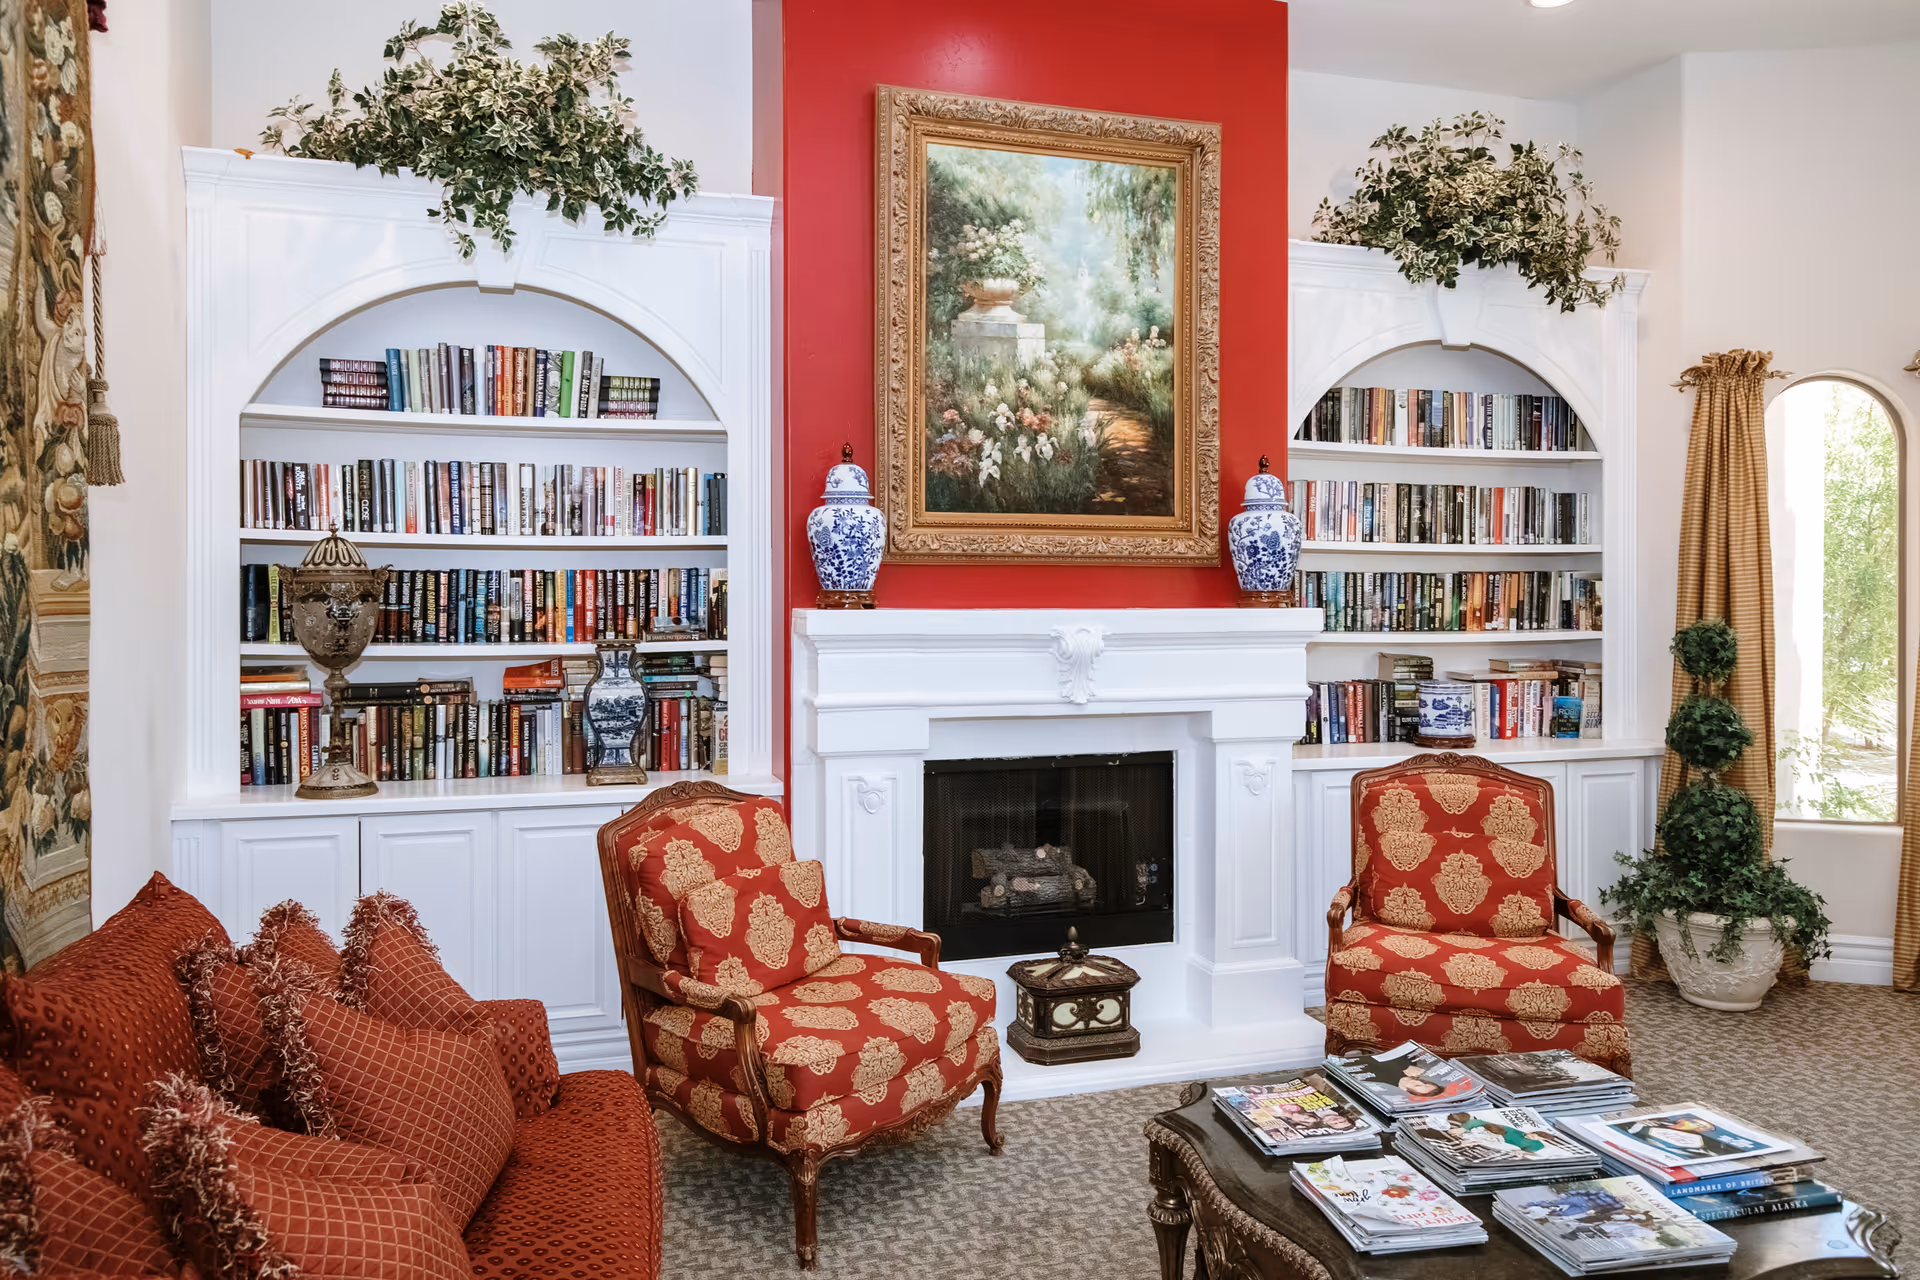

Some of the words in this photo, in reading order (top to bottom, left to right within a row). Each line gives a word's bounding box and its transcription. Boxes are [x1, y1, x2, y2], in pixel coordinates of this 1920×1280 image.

[581, 379, 590, 392] Max
[580, 393, 589, 411] Evans
[451, 480, 459, 498] THOR
[361, 499, 370, 520] CLOSE
[413, 571, 423, 589] JOHN
[427, 572, 436, 590] JOHN
[488, 576, 500, 601] Silva
[413, 589, 423, 618] SANDFORD
[427, 590, 436, 623] SANDFORD
[597, 620, 605, 630] INN
[468, 705, 477, 720] JOHN
[468, 720, 477, 740] GRISHAM
[1500, 1110, 1523, 1128] HOME
[1671, 1183, 1722, 1195] LANDMARKS
[1740, 1177, 1775, 1187] BRITAIN
[1701, 1206, 1766, 1220] SPECTACULAR
[1771, 1200, 1809, 1213] ALASKA
